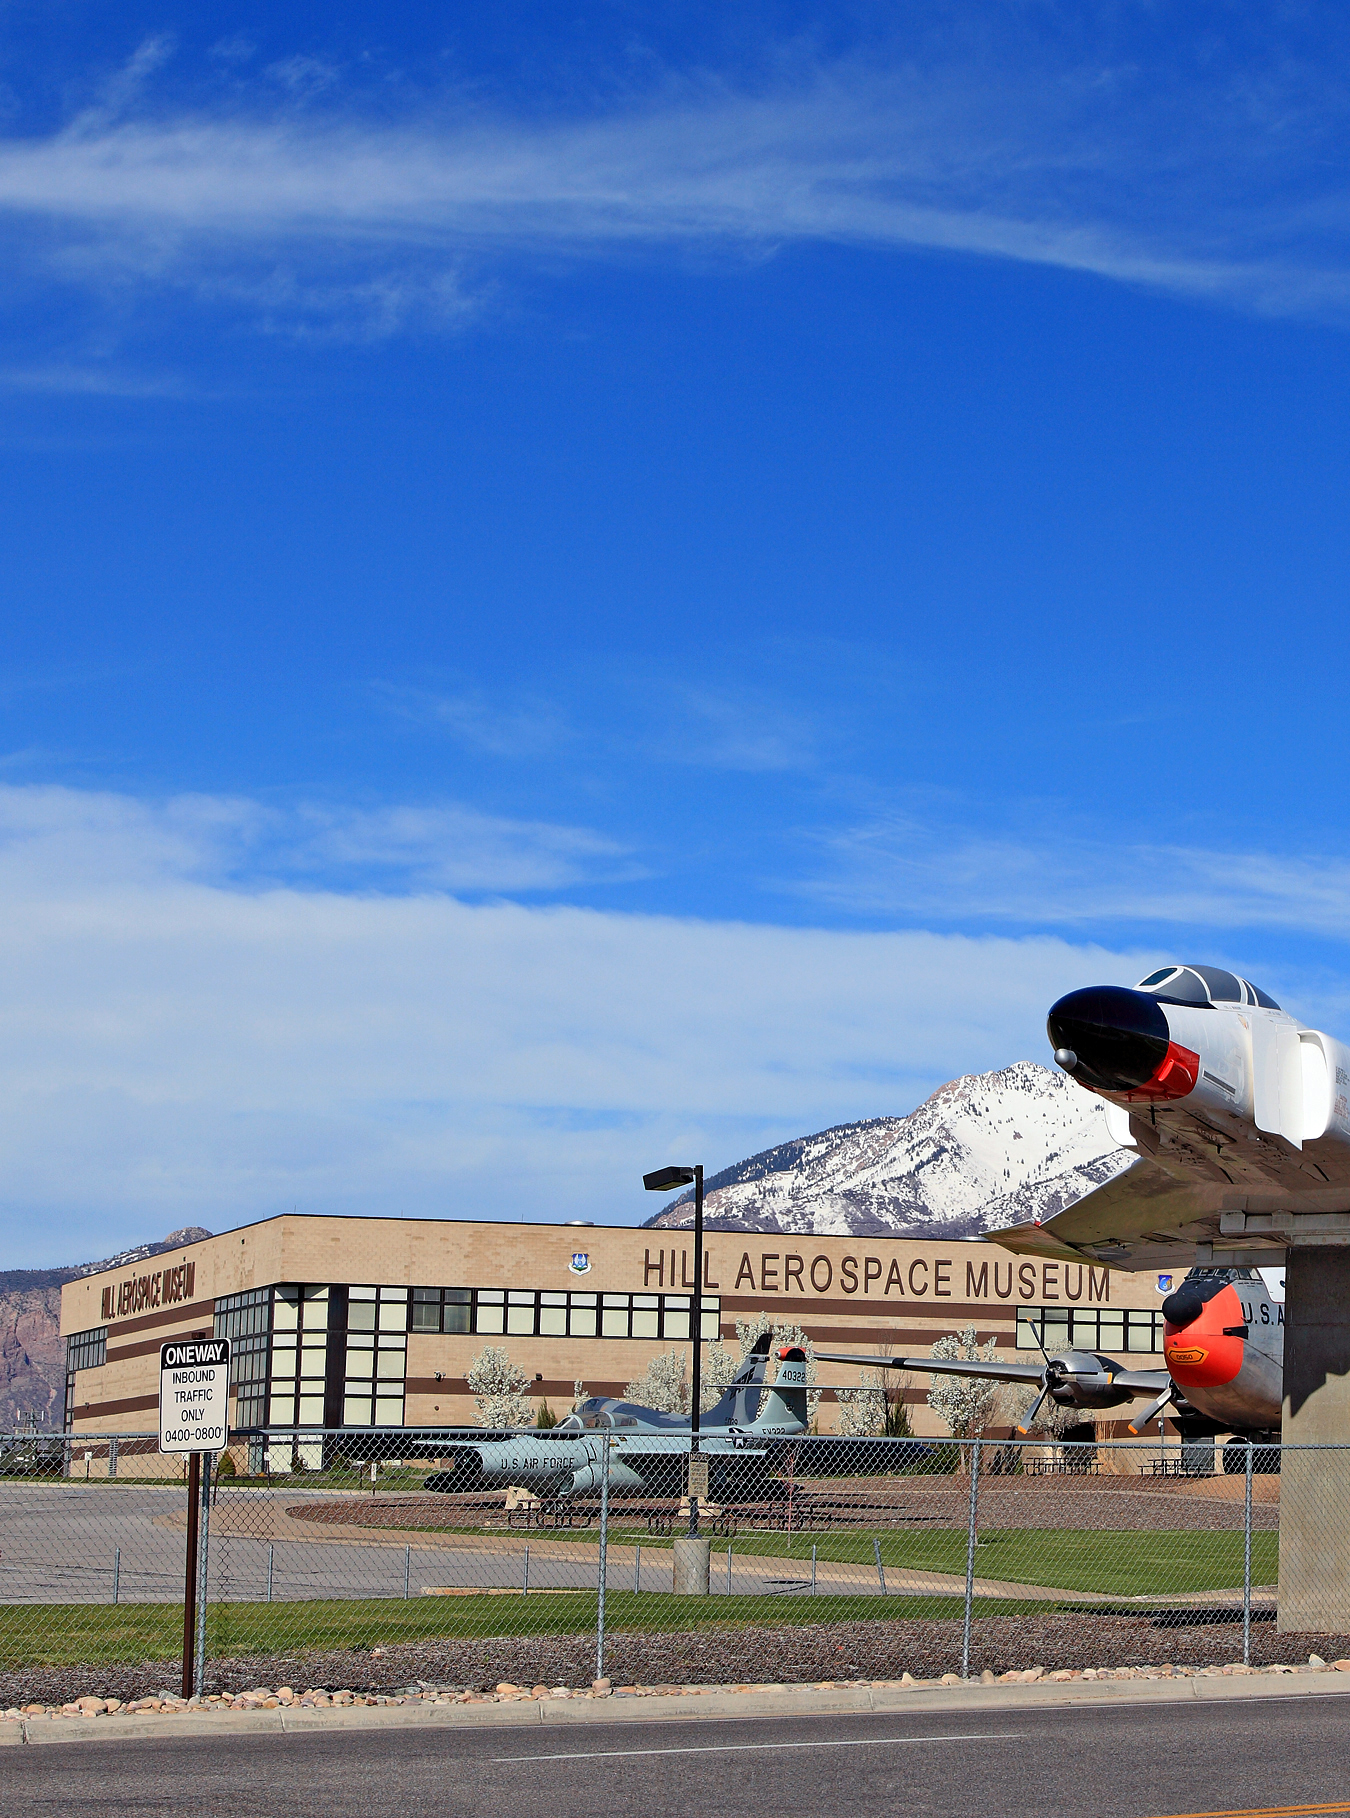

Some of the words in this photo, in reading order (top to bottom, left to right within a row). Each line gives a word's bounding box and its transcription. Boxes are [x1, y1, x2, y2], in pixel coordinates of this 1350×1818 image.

[643, 1248, 719, 1288] HILL
[734, 1252, 952, 1297] AEROSPACE
[966, 1260, 1110, 1301] MUSEUM
[101, 1284, 116, 1321] HILL
[117, 1271, 162, 1316] AEROSPACE
[162, 1261, 195, 1304] MUSEUM
[172, 1369, 215, 1385] INBOUND
[782, 1369, 806, 1382] 40322
[174, 1388, 213, 1403] TRAFFIC
[181, 1408, 205, 1422] ONLY
[165, 1426, 221, 1442] 0400-0800
[523, 1458, 539, 1469] AIR
[543, 1457, 575, 1468] FORCE
